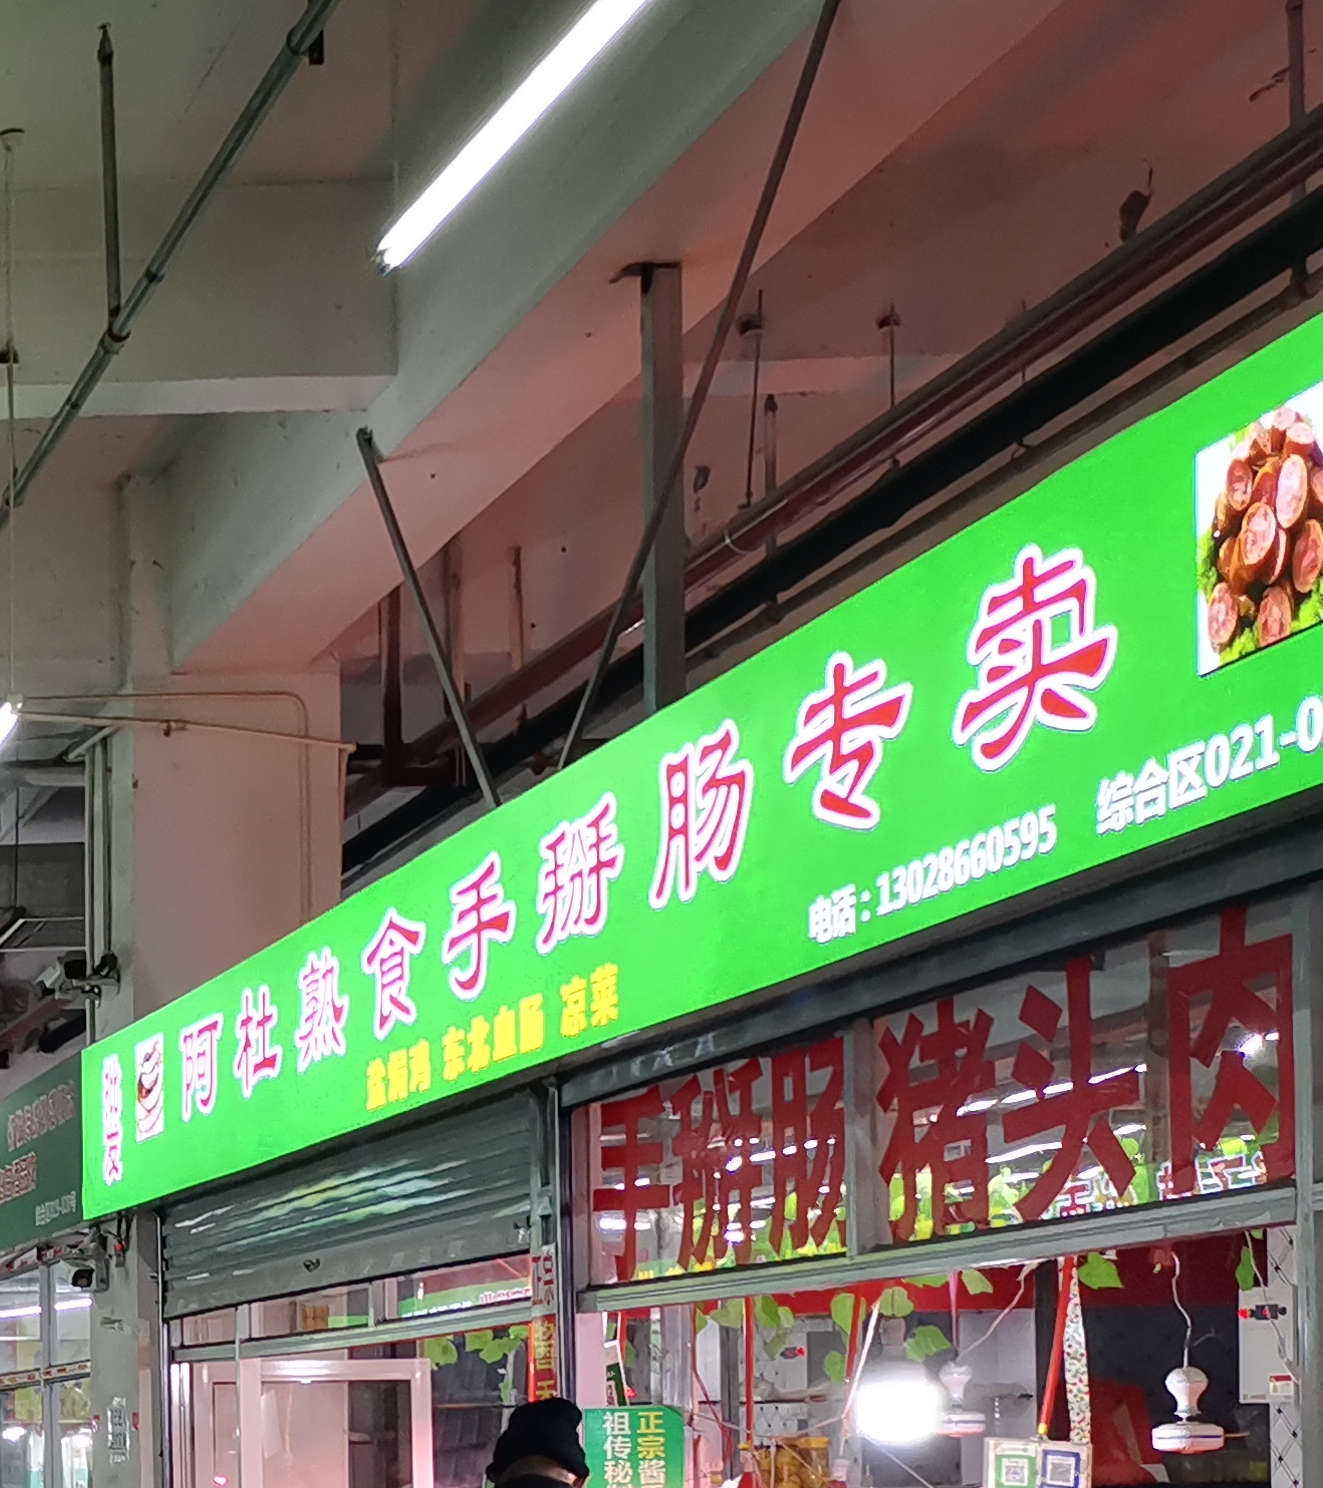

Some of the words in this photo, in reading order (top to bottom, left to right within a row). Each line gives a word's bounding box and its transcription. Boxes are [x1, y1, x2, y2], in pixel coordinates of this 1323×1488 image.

[178, 543, 1118, 1123] 阿杜熟食手掰肠专卖
